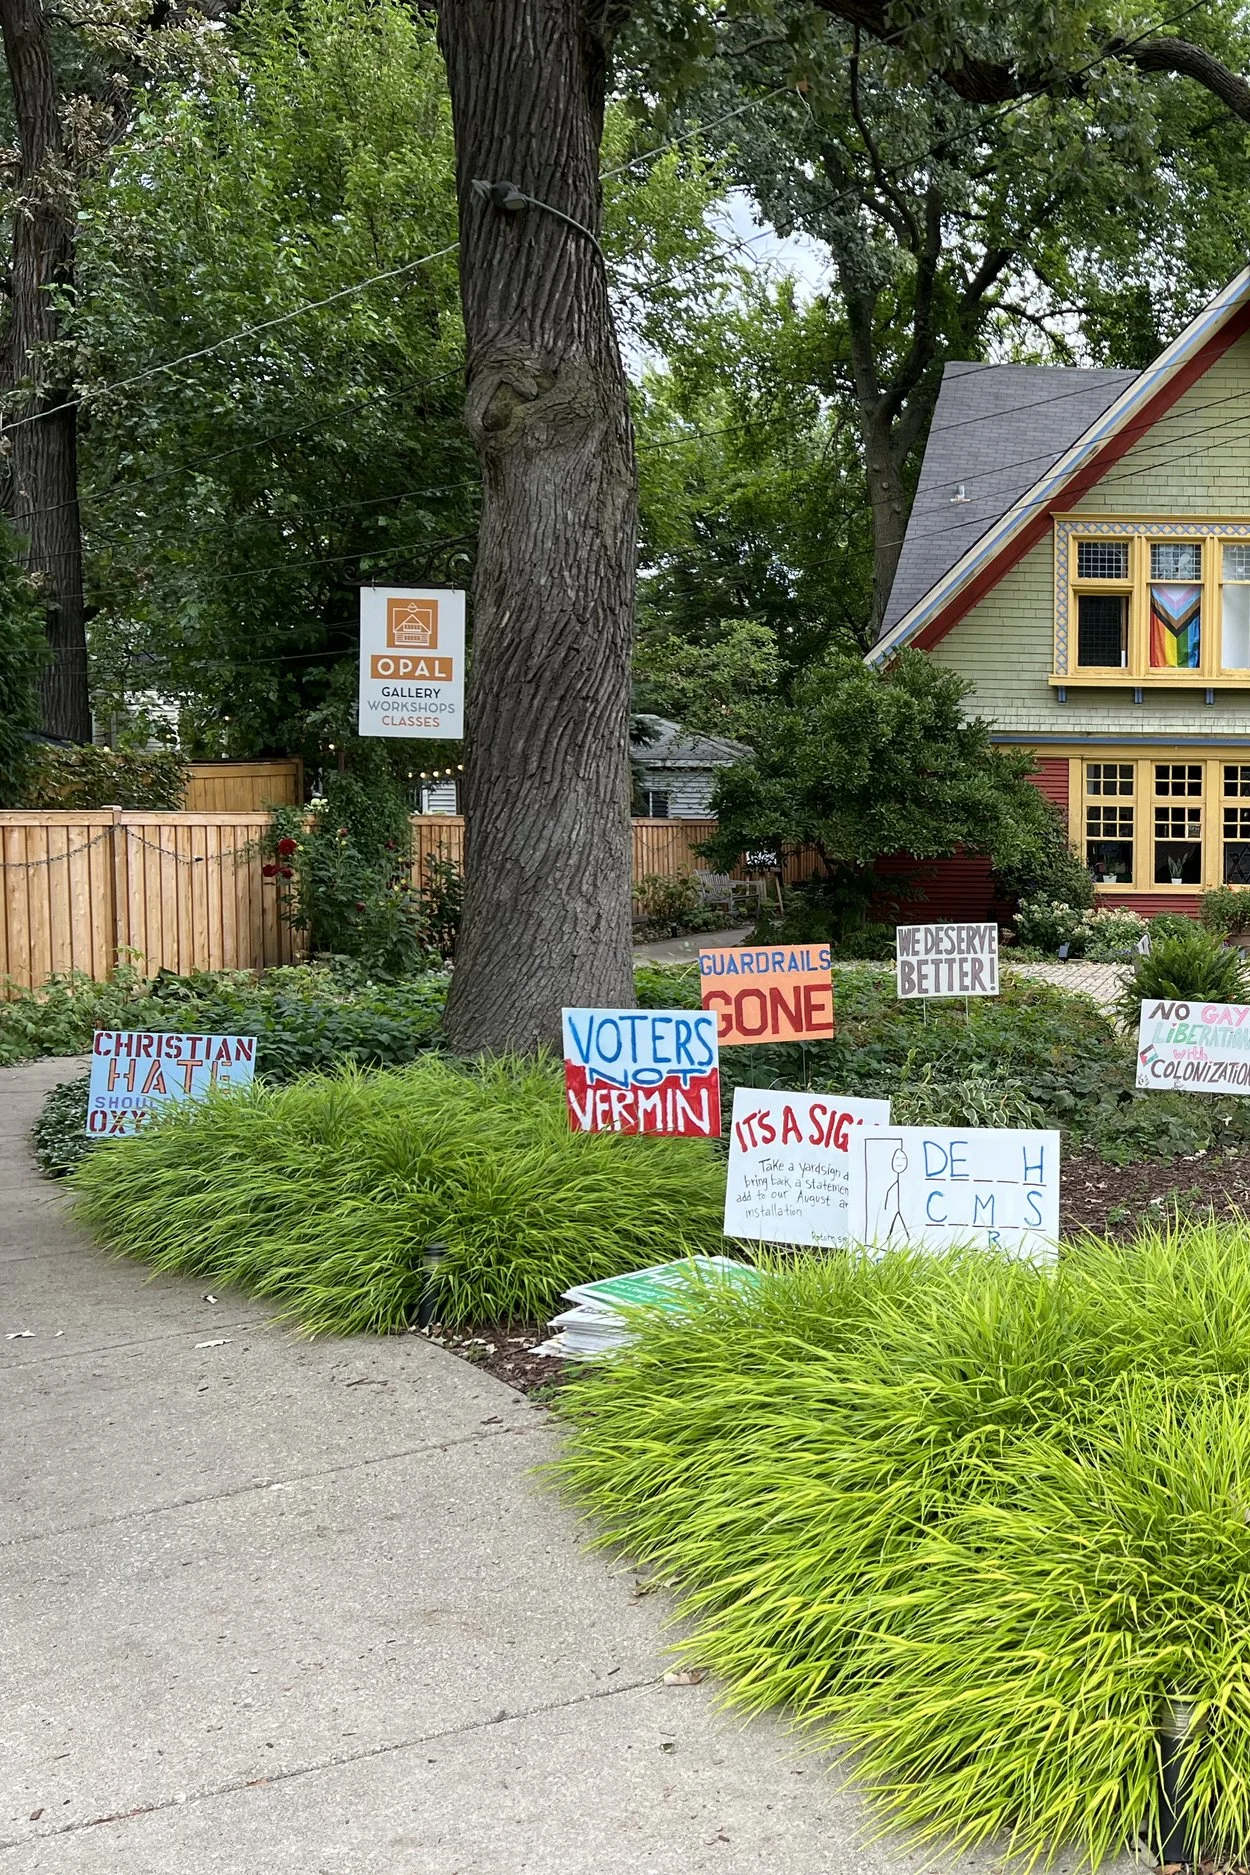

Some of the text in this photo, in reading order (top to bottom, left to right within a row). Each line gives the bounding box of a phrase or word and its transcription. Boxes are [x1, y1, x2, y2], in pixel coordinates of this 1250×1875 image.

[377, 657, 446, 677] OPAL
[381, 686, 441, 698] GALLERY
[368, 701, 455, 713] WORKSHOPS
[382, 715, 440, 727] CLASSES
[898, 925, 996, 957] WE DESERVE
[699, 949, 832, 976] GUARDRAILS
[900, 957, 995, 995] BETTER!
[702, 984, 834, 1038] GONE
[1148, 1002, 1250, 1027] NO GAY
[94, 1032, 253, 1061] CHRISTIAN
[568, 1015, 714, 1066] VOTERS
[1173, 1046, 1209, 1061] with
[107, 1058, 233, 1095] HATE
[588, 1067, 707, 1088] NOT
[568, 1088, 710, 1135] VERMIN
[736, 1104, 863, 1152] IT'S A SIG
[758, 1158, 784, 1172] Take
[788, 1162, 795, 1172] a
[799, 1162, 840, 1181] yardsign
[744, 1175, 768, 1191] bring
[795, 1180, 802, 1188] a
[736, 1191, 752, 1202] add
[757, 1190, 766, 1200] to
[771, 1190, 788, 1199] our
[797, 1190, 831, 1207] August
[745, 1203, 803, 1218] installation
